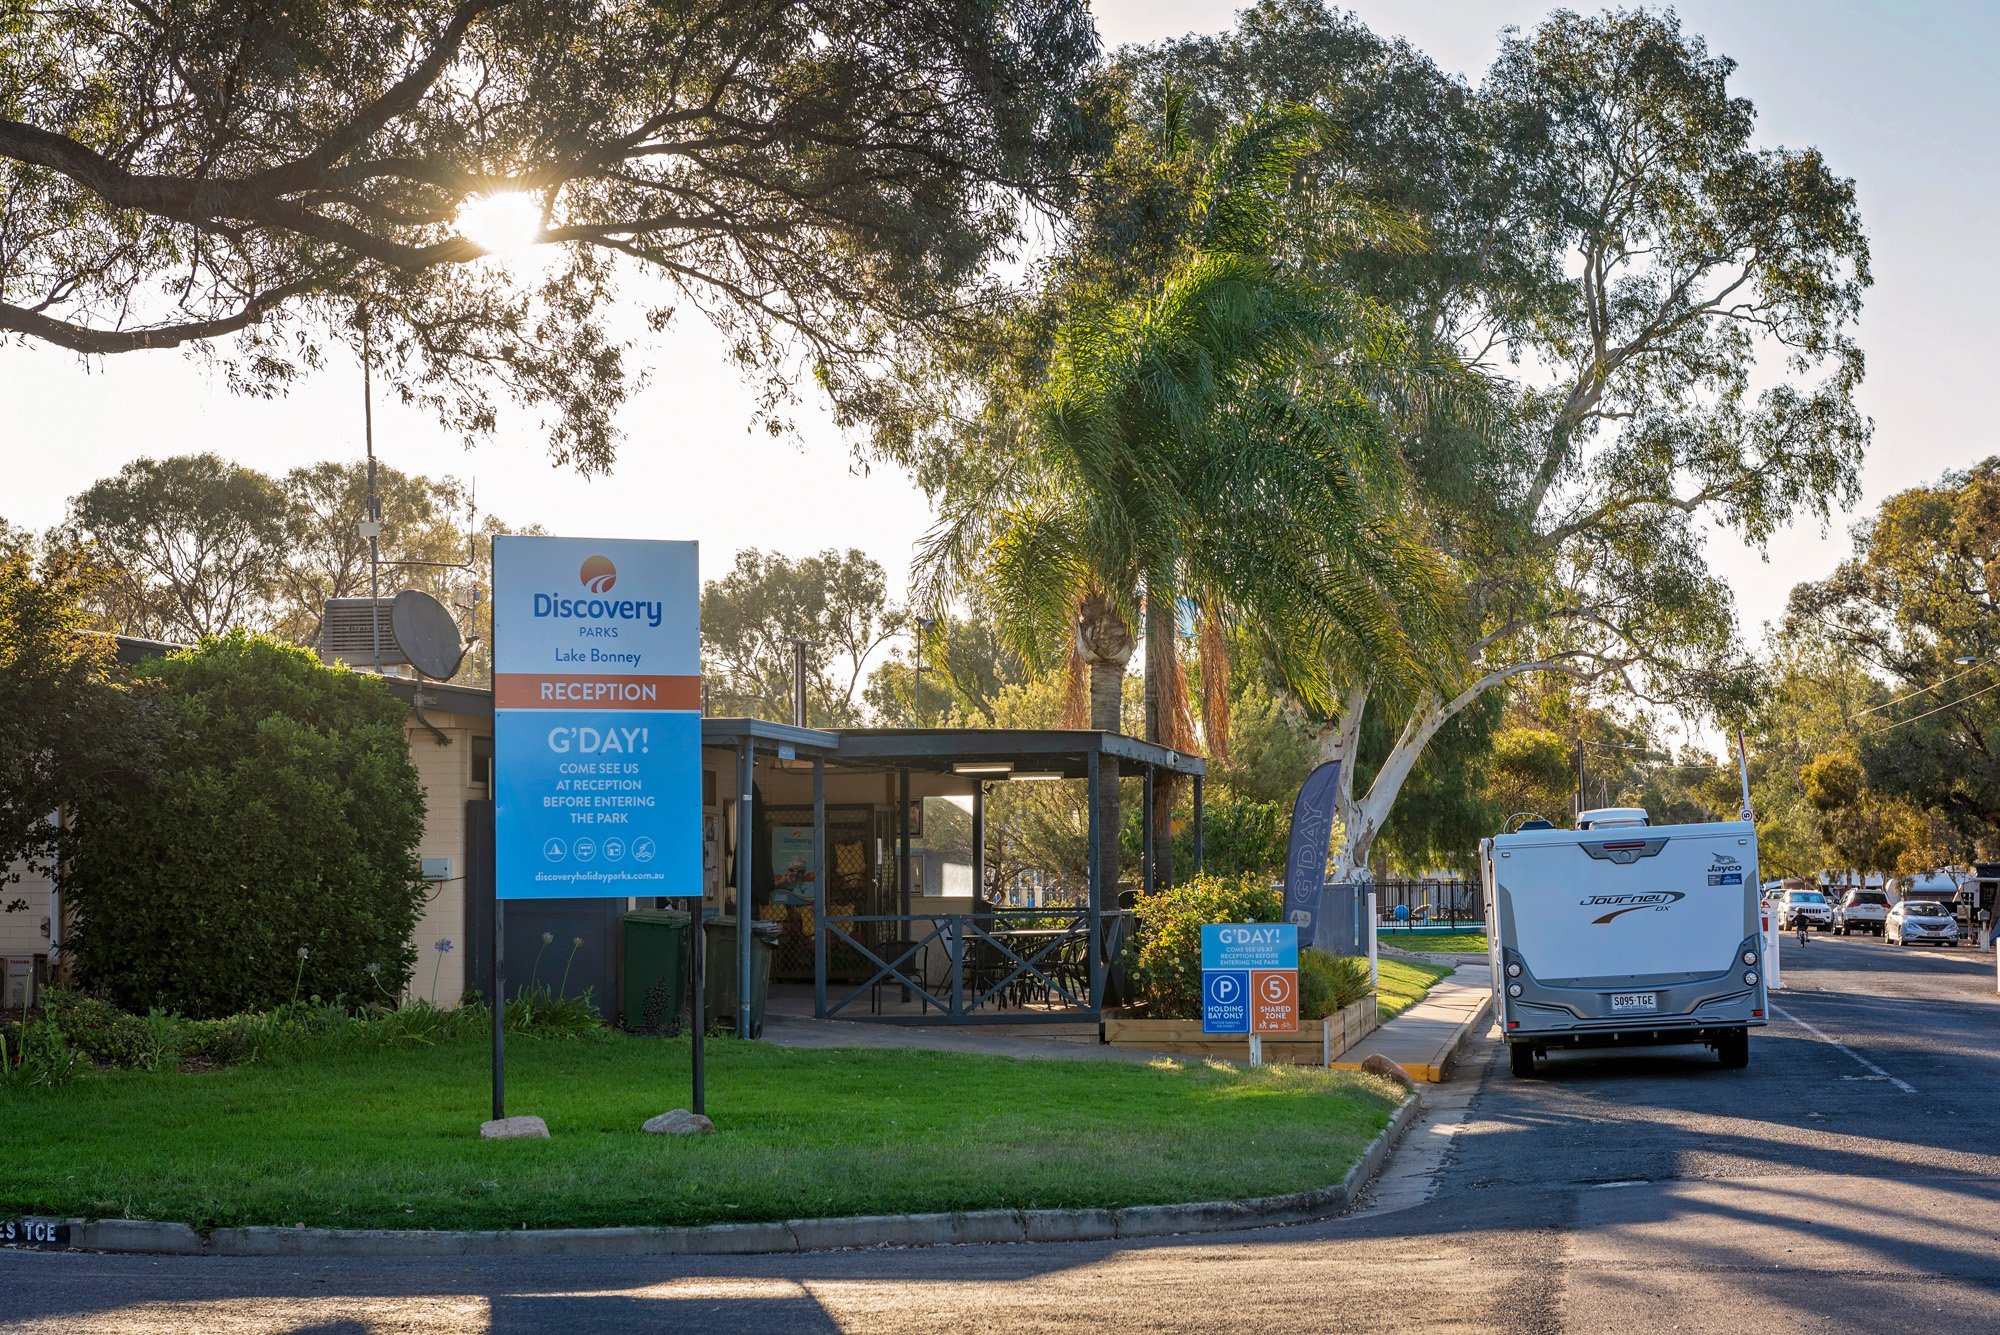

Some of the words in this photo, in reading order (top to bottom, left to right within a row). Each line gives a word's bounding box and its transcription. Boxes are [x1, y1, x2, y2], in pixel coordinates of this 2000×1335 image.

[534, 592, 662, 627] Discovery
[579, 627, 618, 638] PARKS
[555, 648, 586, 662] Lake
[591, 648, 642, 668] Bonney
[540, 682, 657, 701] RECEPTION
[547, 727, 649, 754] G'DAY!
[559, 763, 596, 774] COME
[599, 763, 620, 774] SEE
[623, 763, 639, 774] US
[556, 780, 571, 791] AT
[573, 779, 642, 791] RECEPTION
[543, 796, 592, 807] BEFORE
[594, 796, 655, 807] ENTERING
[570, 813, 594, 824] THE
[597, 813, 629, 824] PARK
[1294, 800, 1322, 903] G'DAY
[1707, 864, 1742, 873] Jayco
[535, 871, 665, 884] discoveryholidayparks.com.au
[1580, 892, 1670, 906] Journey
[1219, 929, 1280, 944] G'DAY!
[1220, 981, 1232, 999] P
[1269, 981, 1282, 999] 5
[24, 1221, 56, 1242] TCE
